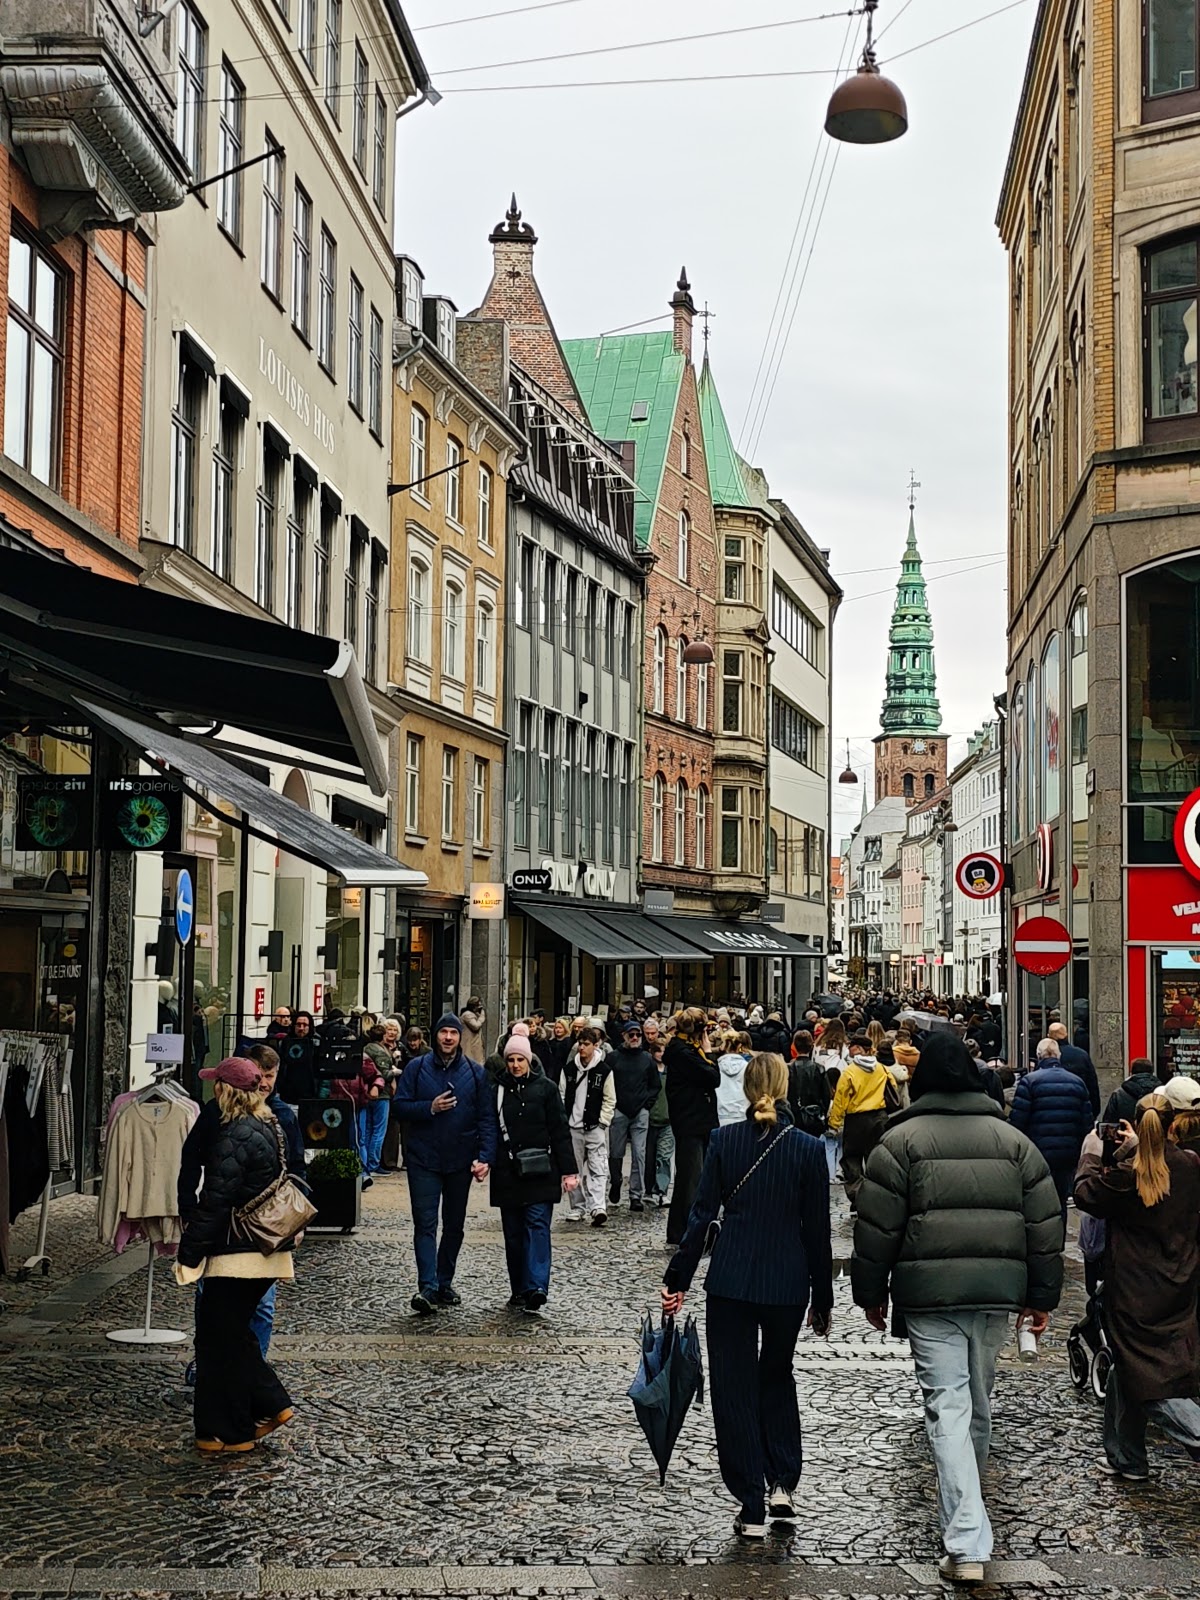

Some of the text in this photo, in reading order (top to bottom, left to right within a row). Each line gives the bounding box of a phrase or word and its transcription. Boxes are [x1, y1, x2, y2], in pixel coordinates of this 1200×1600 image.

[258, 335, 336, 455] LOUISES HUS
[514, 874, 549, 885] ONLY
[583, 866, 617, 898] ONLY
[973, 870, 983, 878] BR
[703, 930, 788, 950] MESSAGE
